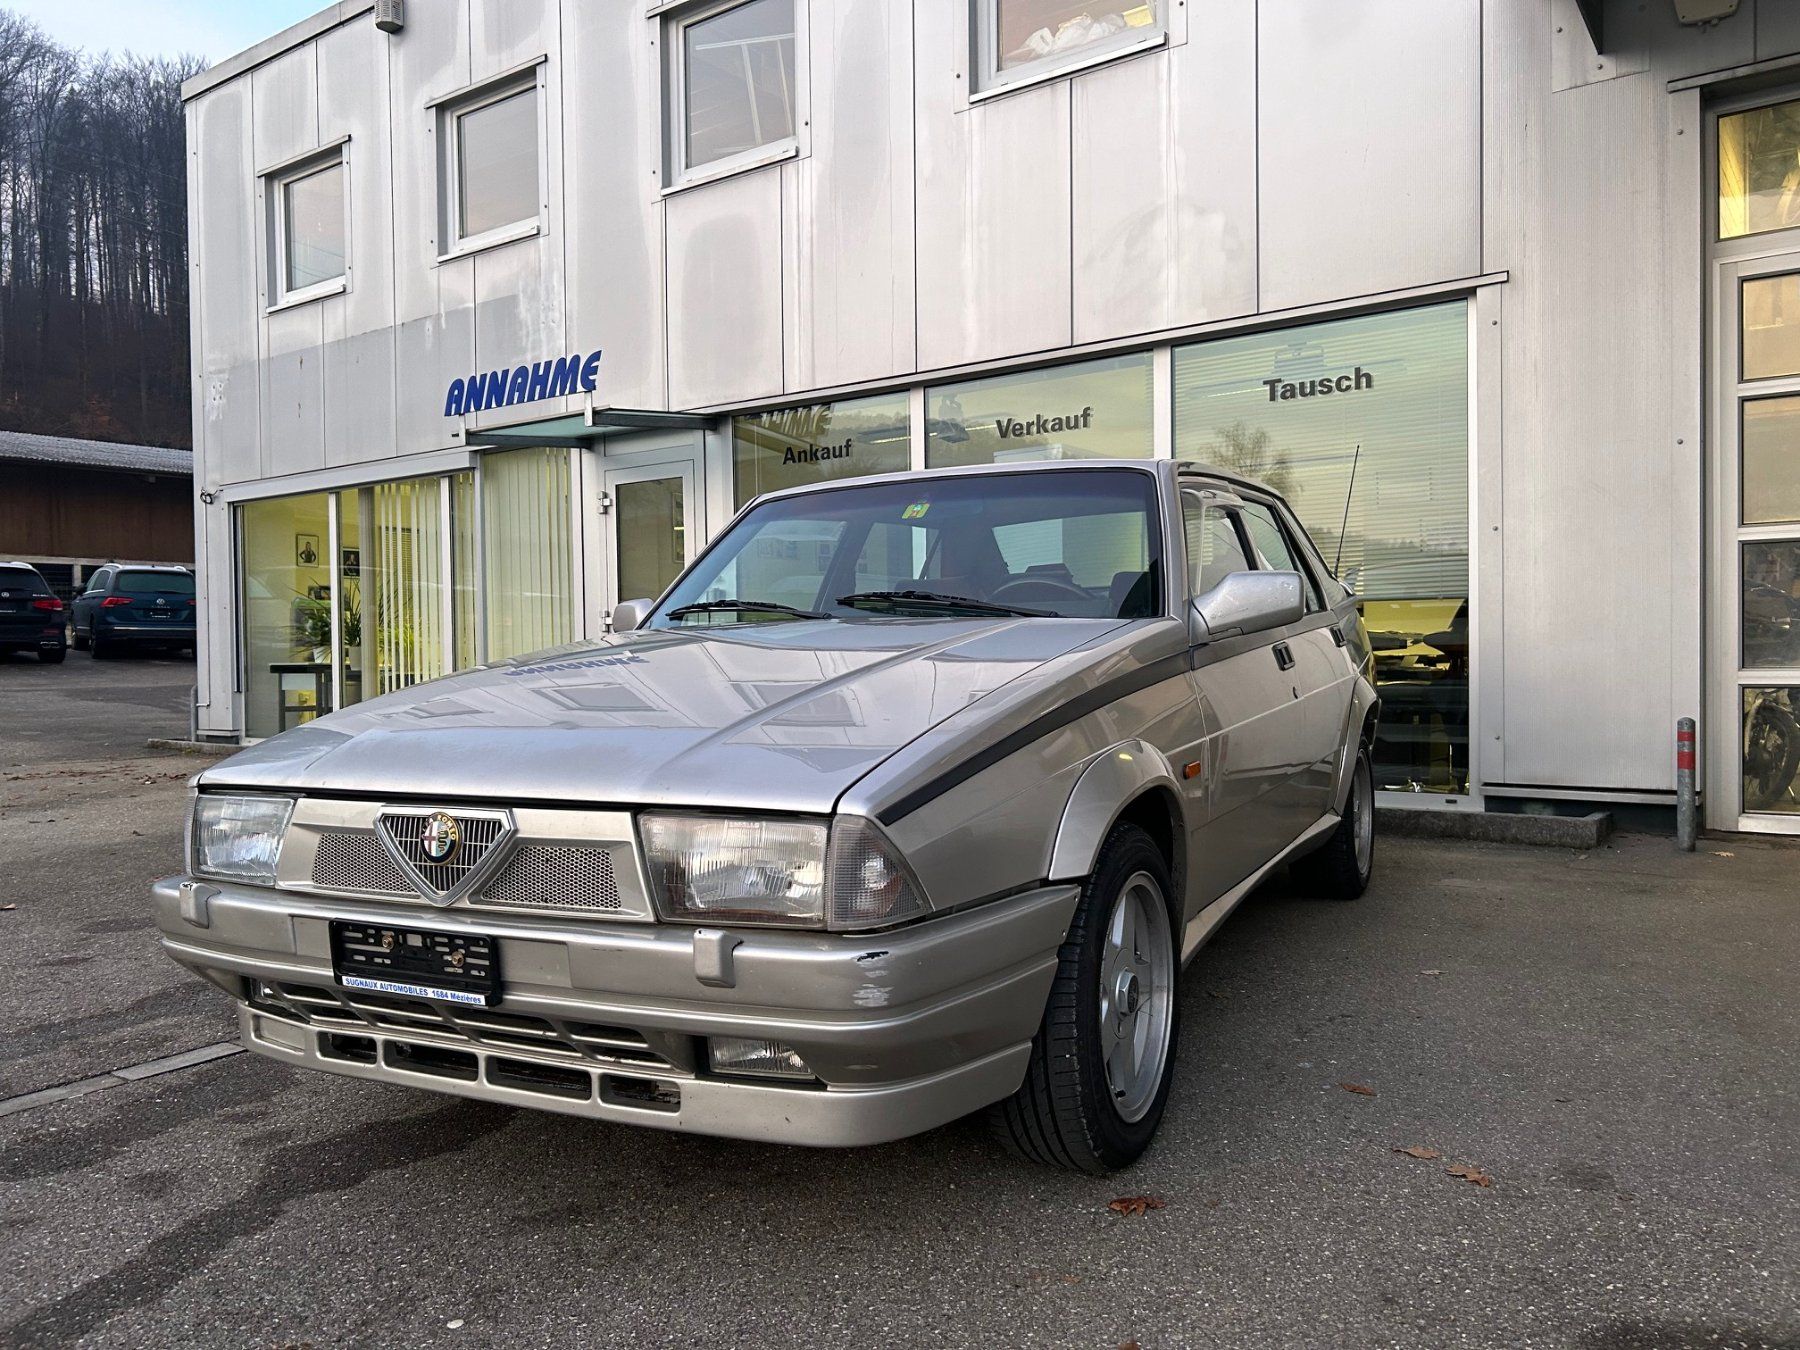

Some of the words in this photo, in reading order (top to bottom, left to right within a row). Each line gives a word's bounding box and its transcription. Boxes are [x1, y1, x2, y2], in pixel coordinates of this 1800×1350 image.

[444, 350, 602, 416] ANNAHME
[1263, 367, 1372, 402] Tausch
[996, 406, 1093, 438] Verkauf
[783, 438, 852, 465] Ankauf
[345, 977, 378, 989] SUGNAUX
[380, 982, 429, 996] AUTOMOBILES
